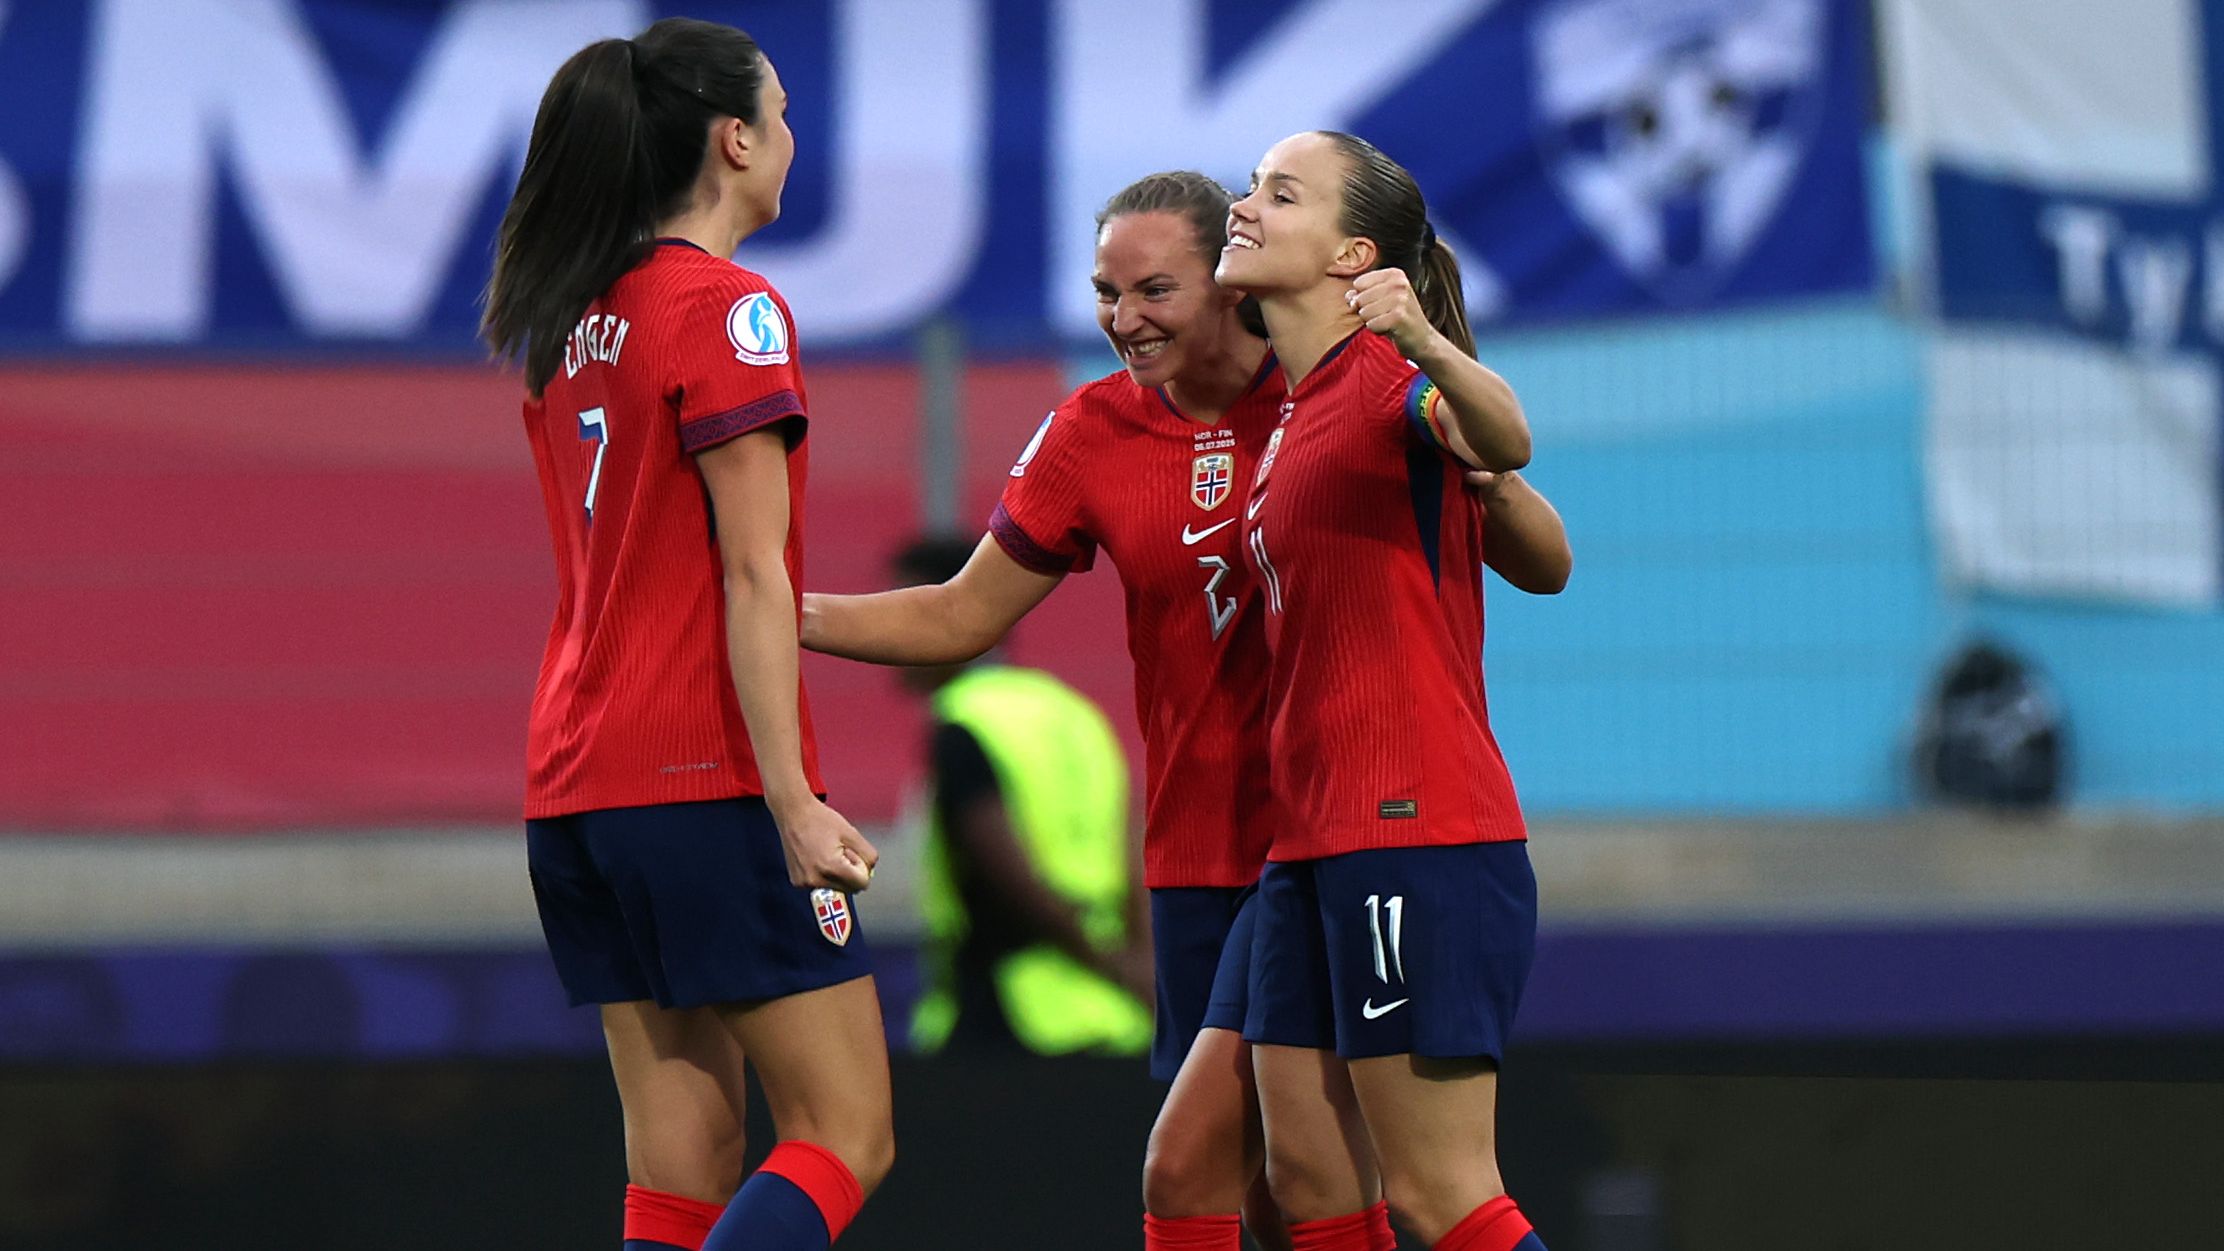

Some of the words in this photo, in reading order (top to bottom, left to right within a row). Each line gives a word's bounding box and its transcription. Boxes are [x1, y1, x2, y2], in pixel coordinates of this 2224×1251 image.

[578, 406, 608, 518] 7
[1197, 554, 1237, 641] 2
[1249, 526, 1284, 616] 11
[1364, 894, 1405, 984] 11
